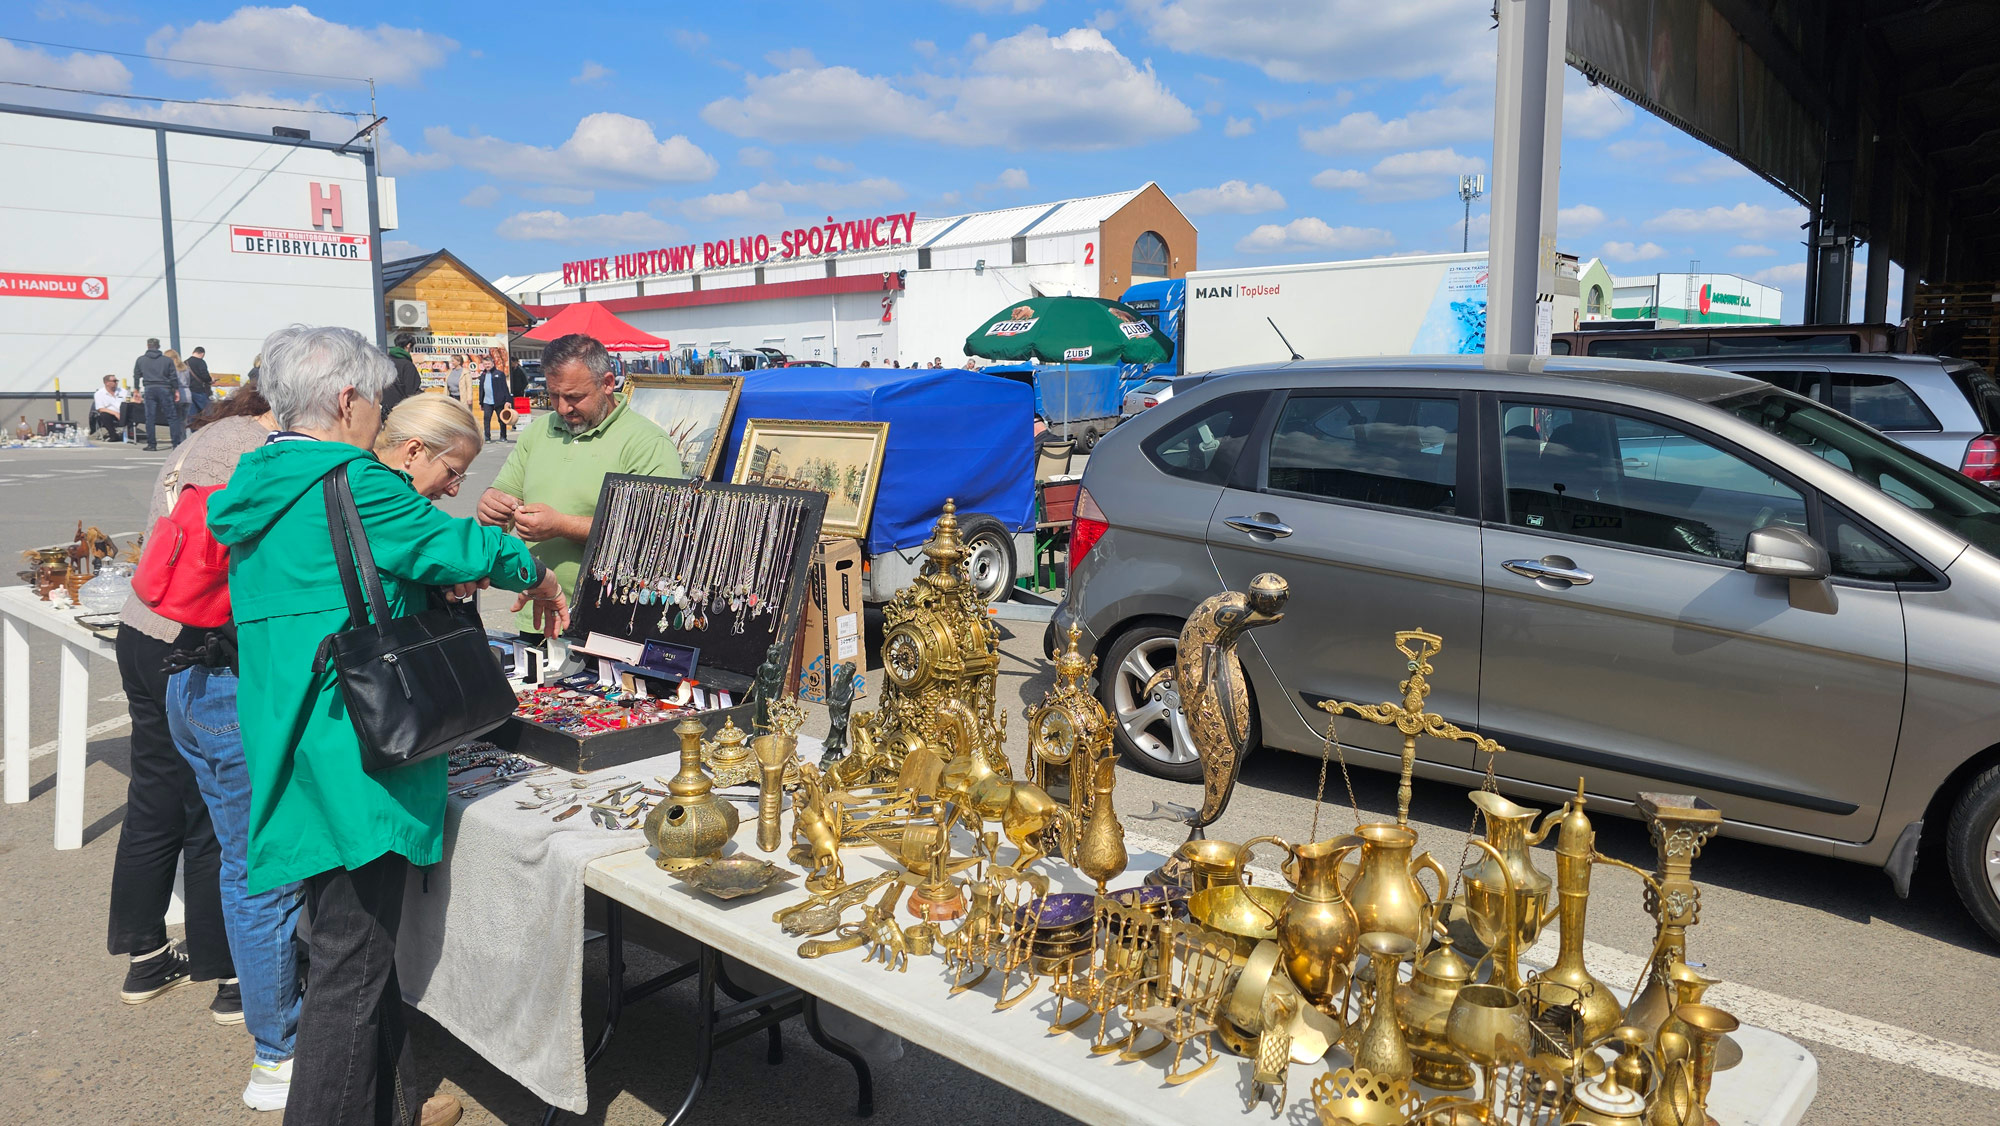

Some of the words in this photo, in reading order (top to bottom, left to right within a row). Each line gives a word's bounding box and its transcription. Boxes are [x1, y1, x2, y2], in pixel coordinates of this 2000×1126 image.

[310, 182, 342, 228] H
[246, 236, 358, 259] DEFIBRYLATOR
[562, 257, 610, 285] RYNEK
[615, 244, 696, 279] HURTOWY
[703, 234, 777, 268] ROLNO-
[781, 211, 917, 259] SPOŻYWCZY
[1084, 242, 1095, 265] 2
[11, 279, 16, 289] I
[19, 279, 77, 292] HANDLU
[1196, 286, 1232, 299] MAN
[1241, 284, 1280, 298] TopUsed
[882, 297, 892, 323] 2
[1136, 302, 1156, 310] MAN
[814, 348, 821, 356] 22
[871, 346, 878, 354] 21
